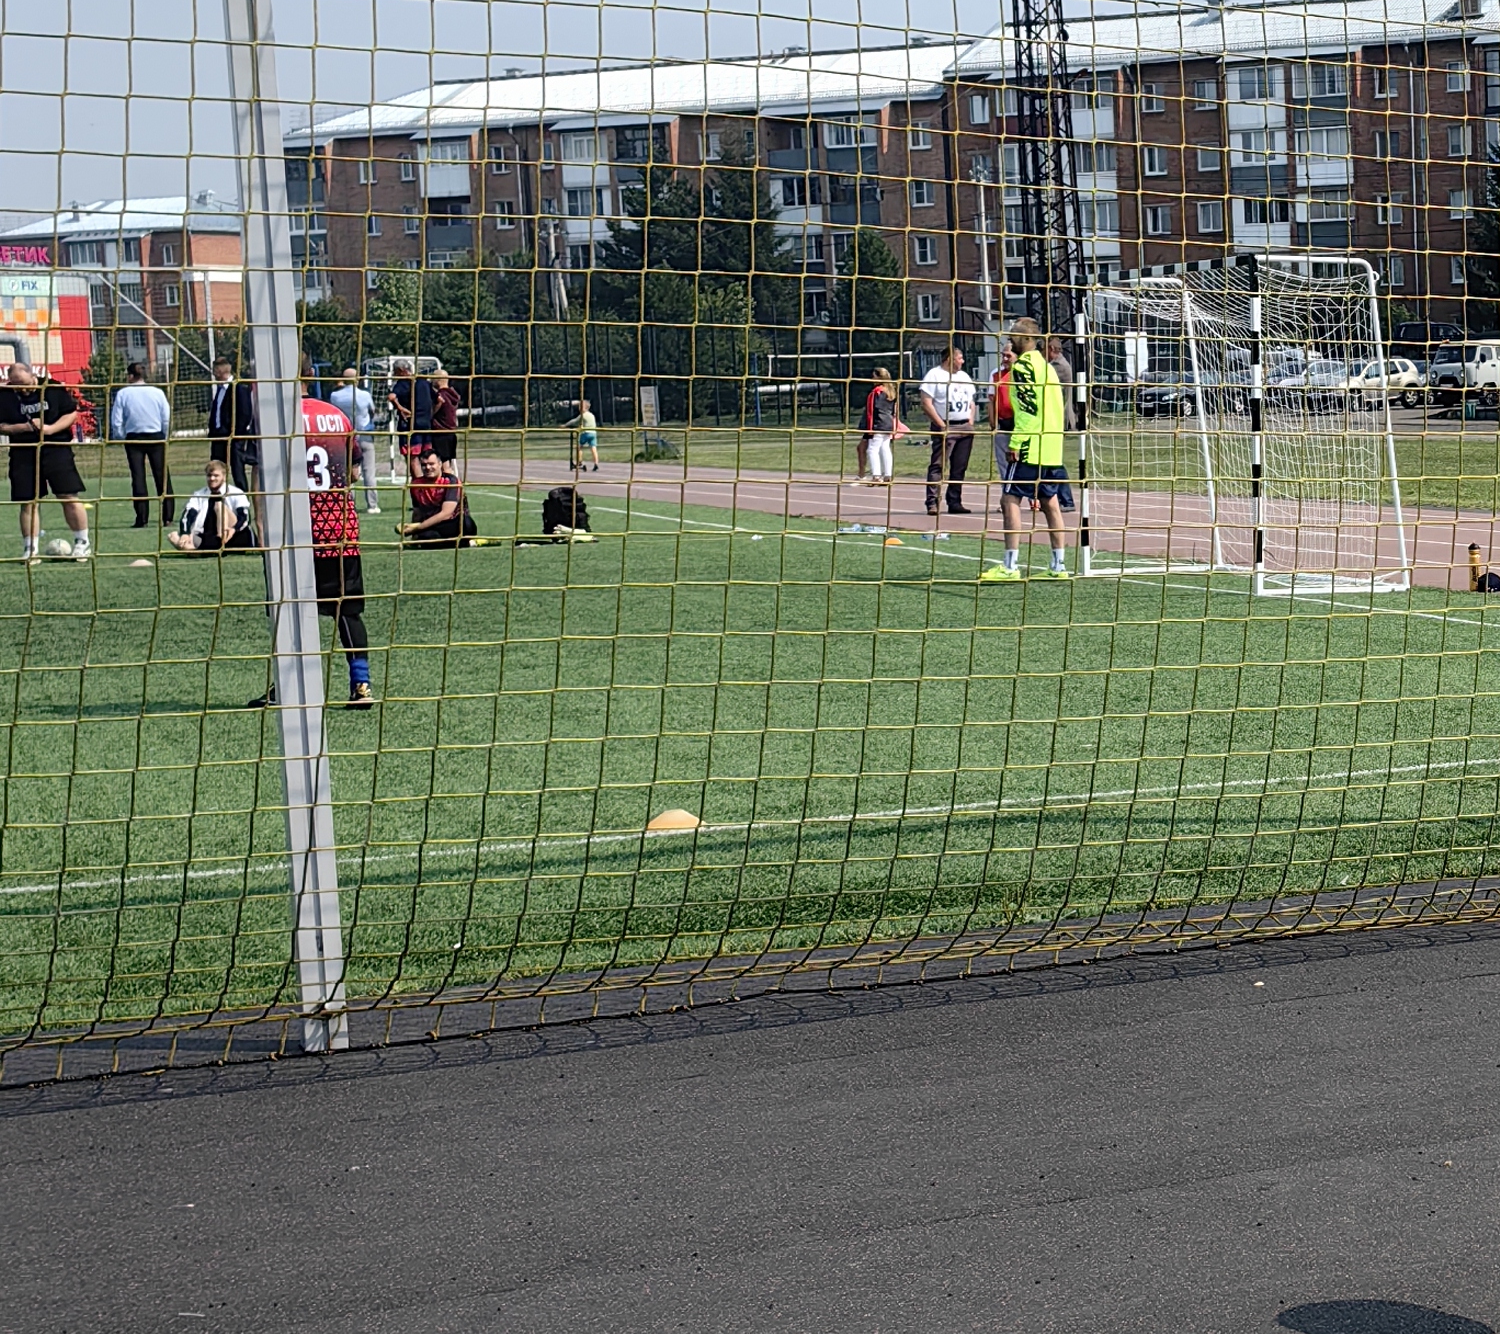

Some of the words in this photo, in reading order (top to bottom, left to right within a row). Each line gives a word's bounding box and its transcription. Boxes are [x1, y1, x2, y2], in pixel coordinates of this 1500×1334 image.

[0, 246, 51, 264] ЕТИК
[21, 280, 38, 291] FIX
[316, 414, 345, 433] ОСП
